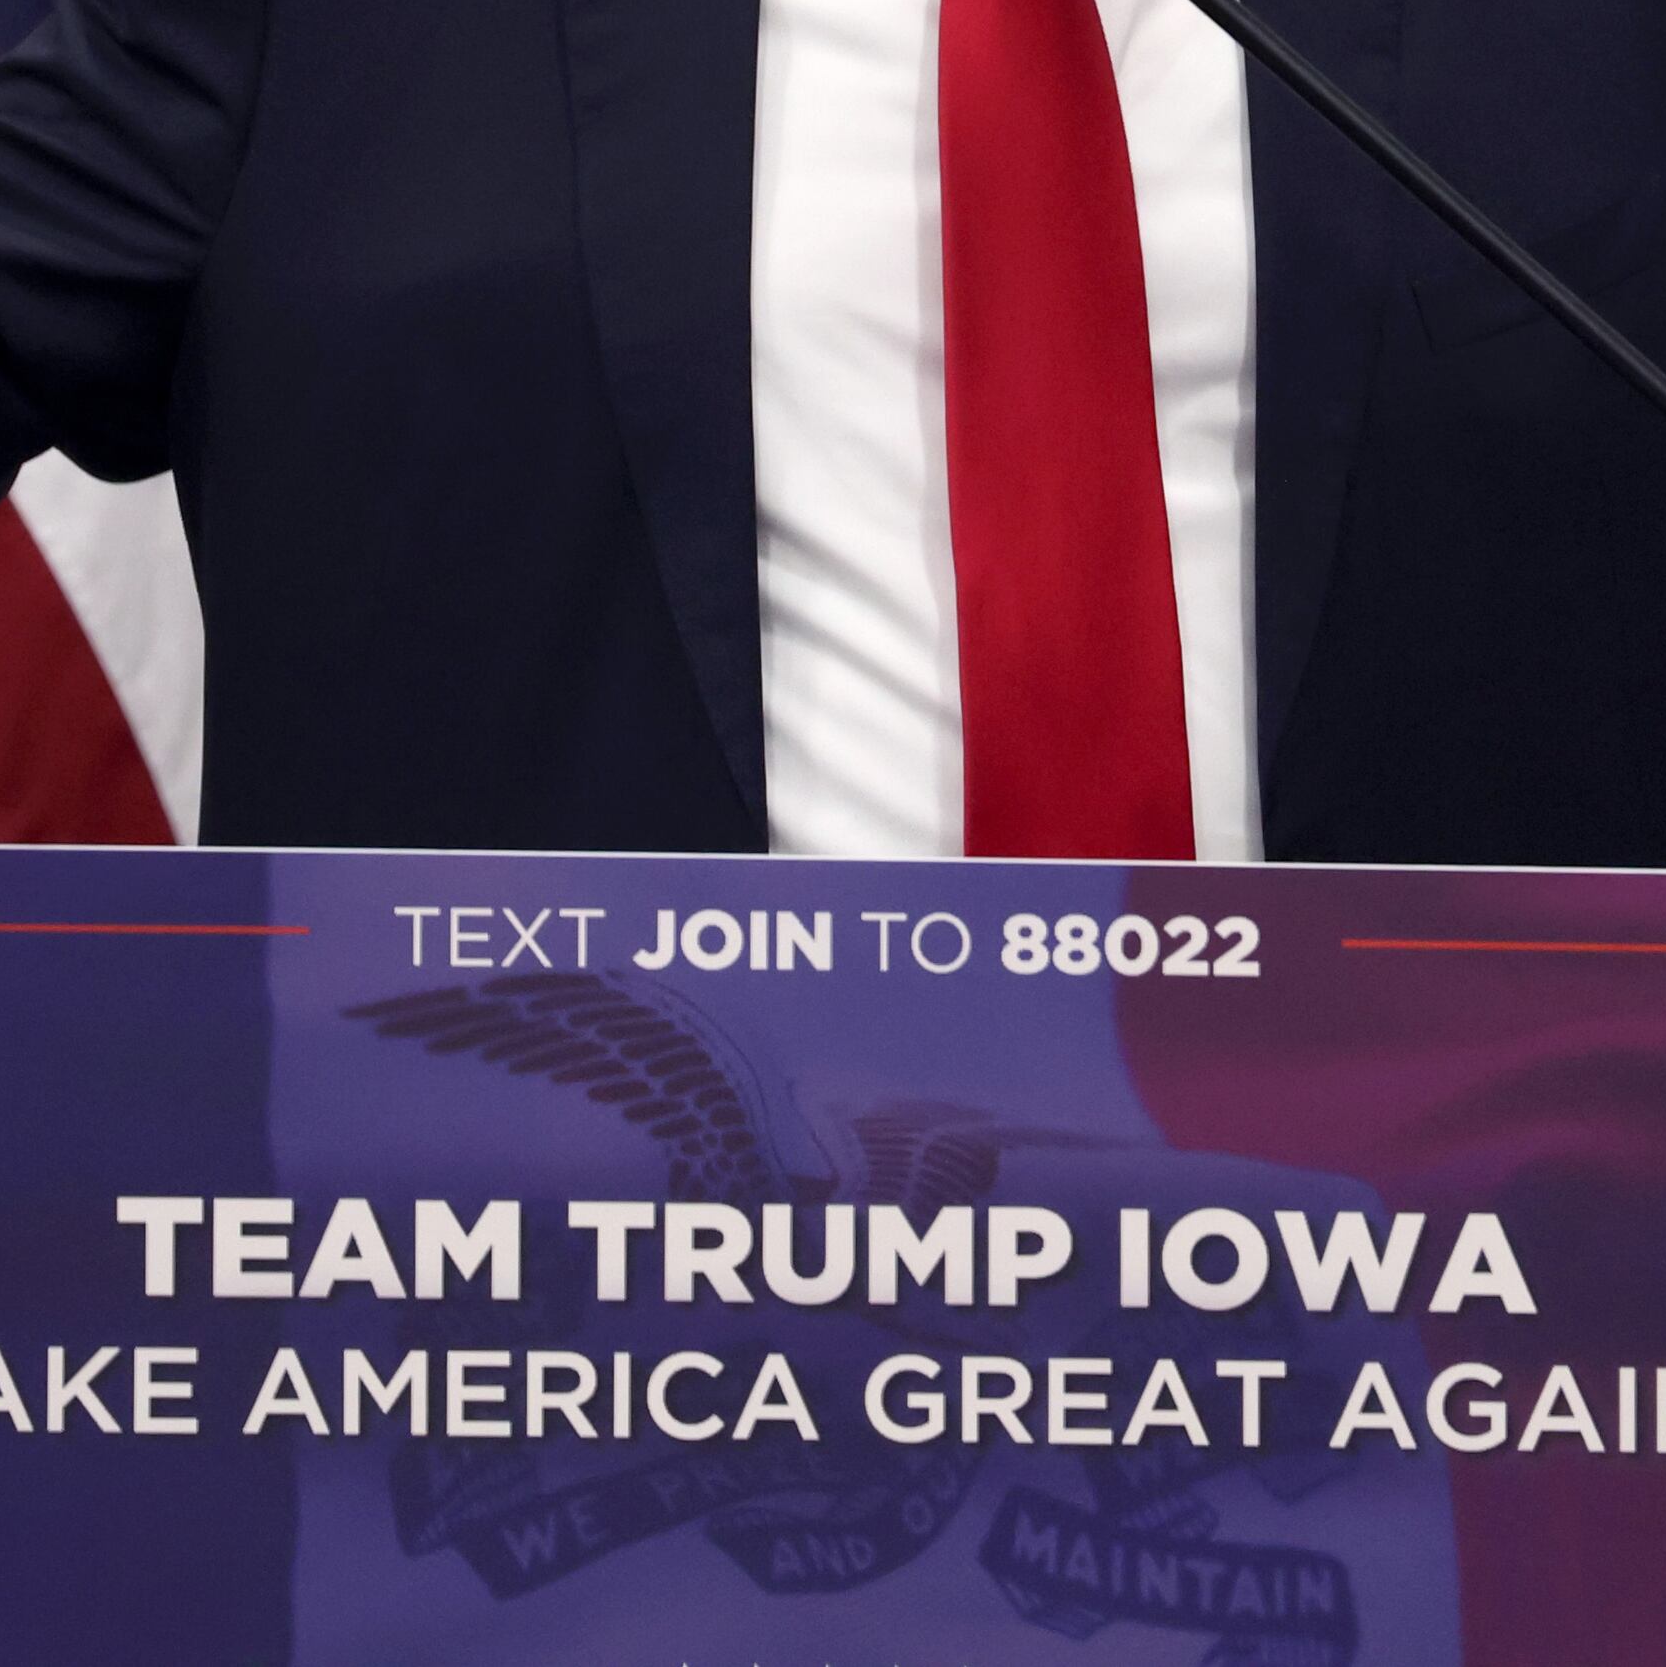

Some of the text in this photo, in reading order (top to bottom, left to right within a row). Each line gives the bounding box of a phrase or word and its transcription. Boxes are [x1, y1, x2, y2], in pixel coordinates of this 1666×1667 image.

[394, 906, 1261, 978] TEXT JOIN TO 88022
[116, 1196, 1538, 1315] TEAM TRUMP IOWA
[241, 1348, 820, 1441] AMERICA
[863, 1354, 1287, 1448] GREAT
[497, 1492, 613, 1571] WE
[768, 1531, 880, 1581] AND
[1011, 1505, 1337, 1621] MAINTAIN
